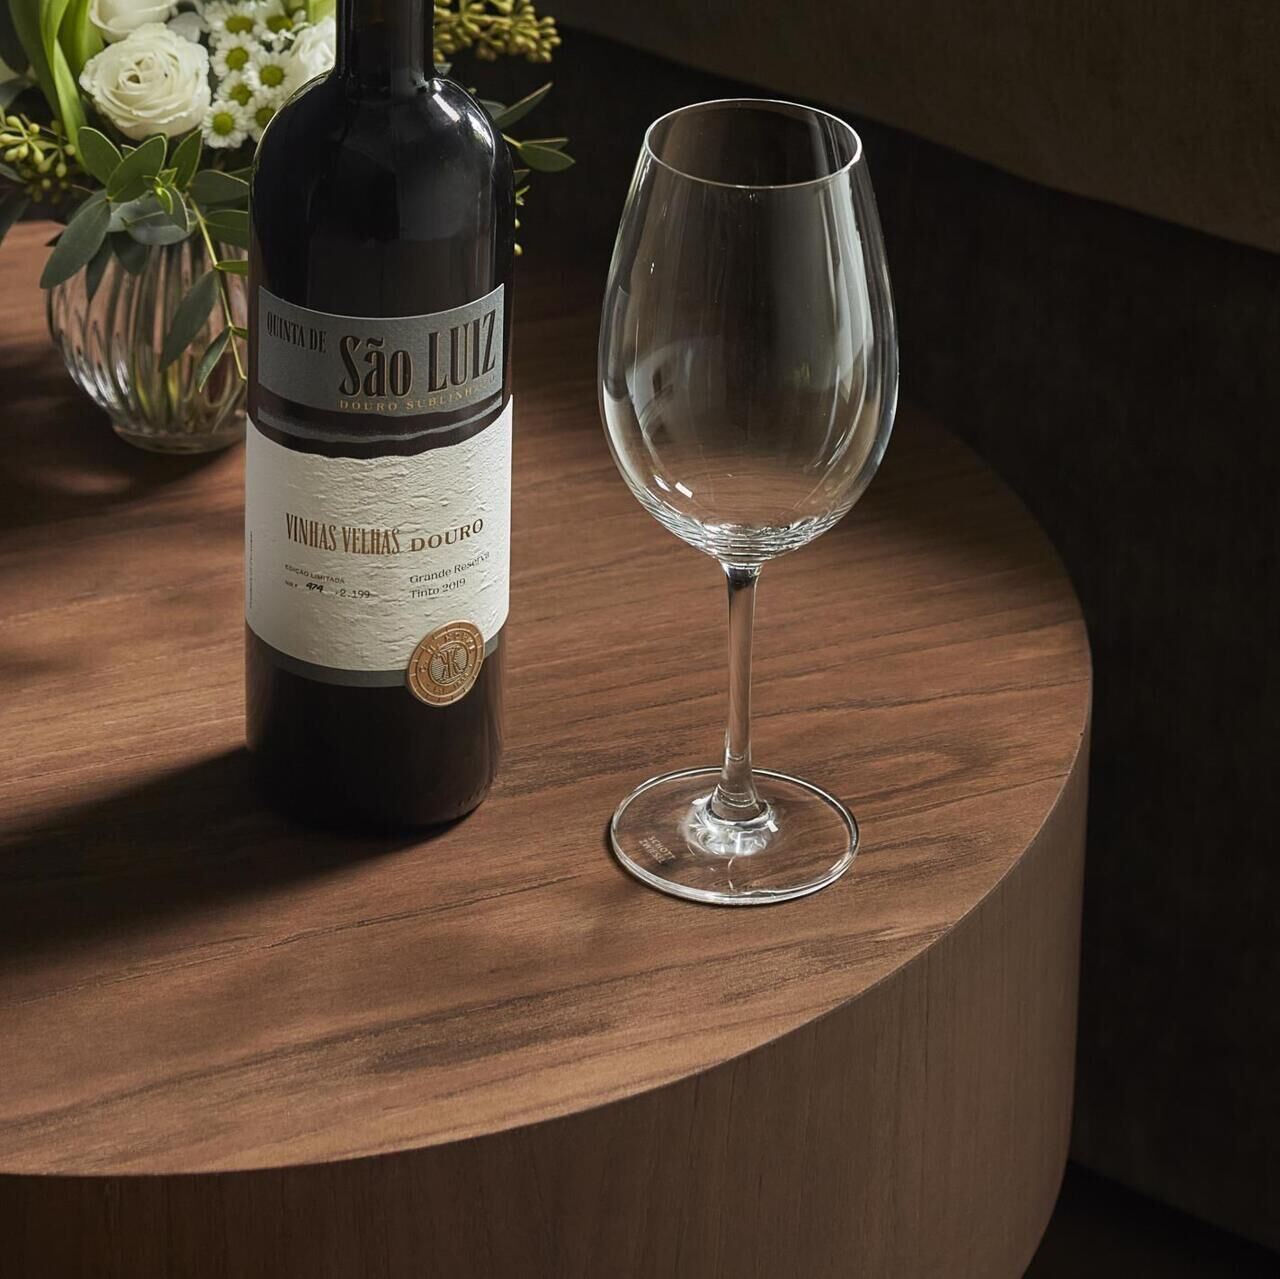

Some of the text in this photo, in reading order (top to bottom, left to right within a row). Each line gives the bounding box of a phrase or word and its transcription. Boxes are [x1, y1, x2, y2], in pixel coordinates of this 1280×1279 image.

[266, 309, 497, 398] QUINTA DE São LUIZ
[339, 399, 398, 412] DOURO
[285, 512, 484, 556] VINHAS VELHAS DOURO
[409, 551, 490, 584] Grande Reserva
[409, 577, 466, 599] Tinto 2019
